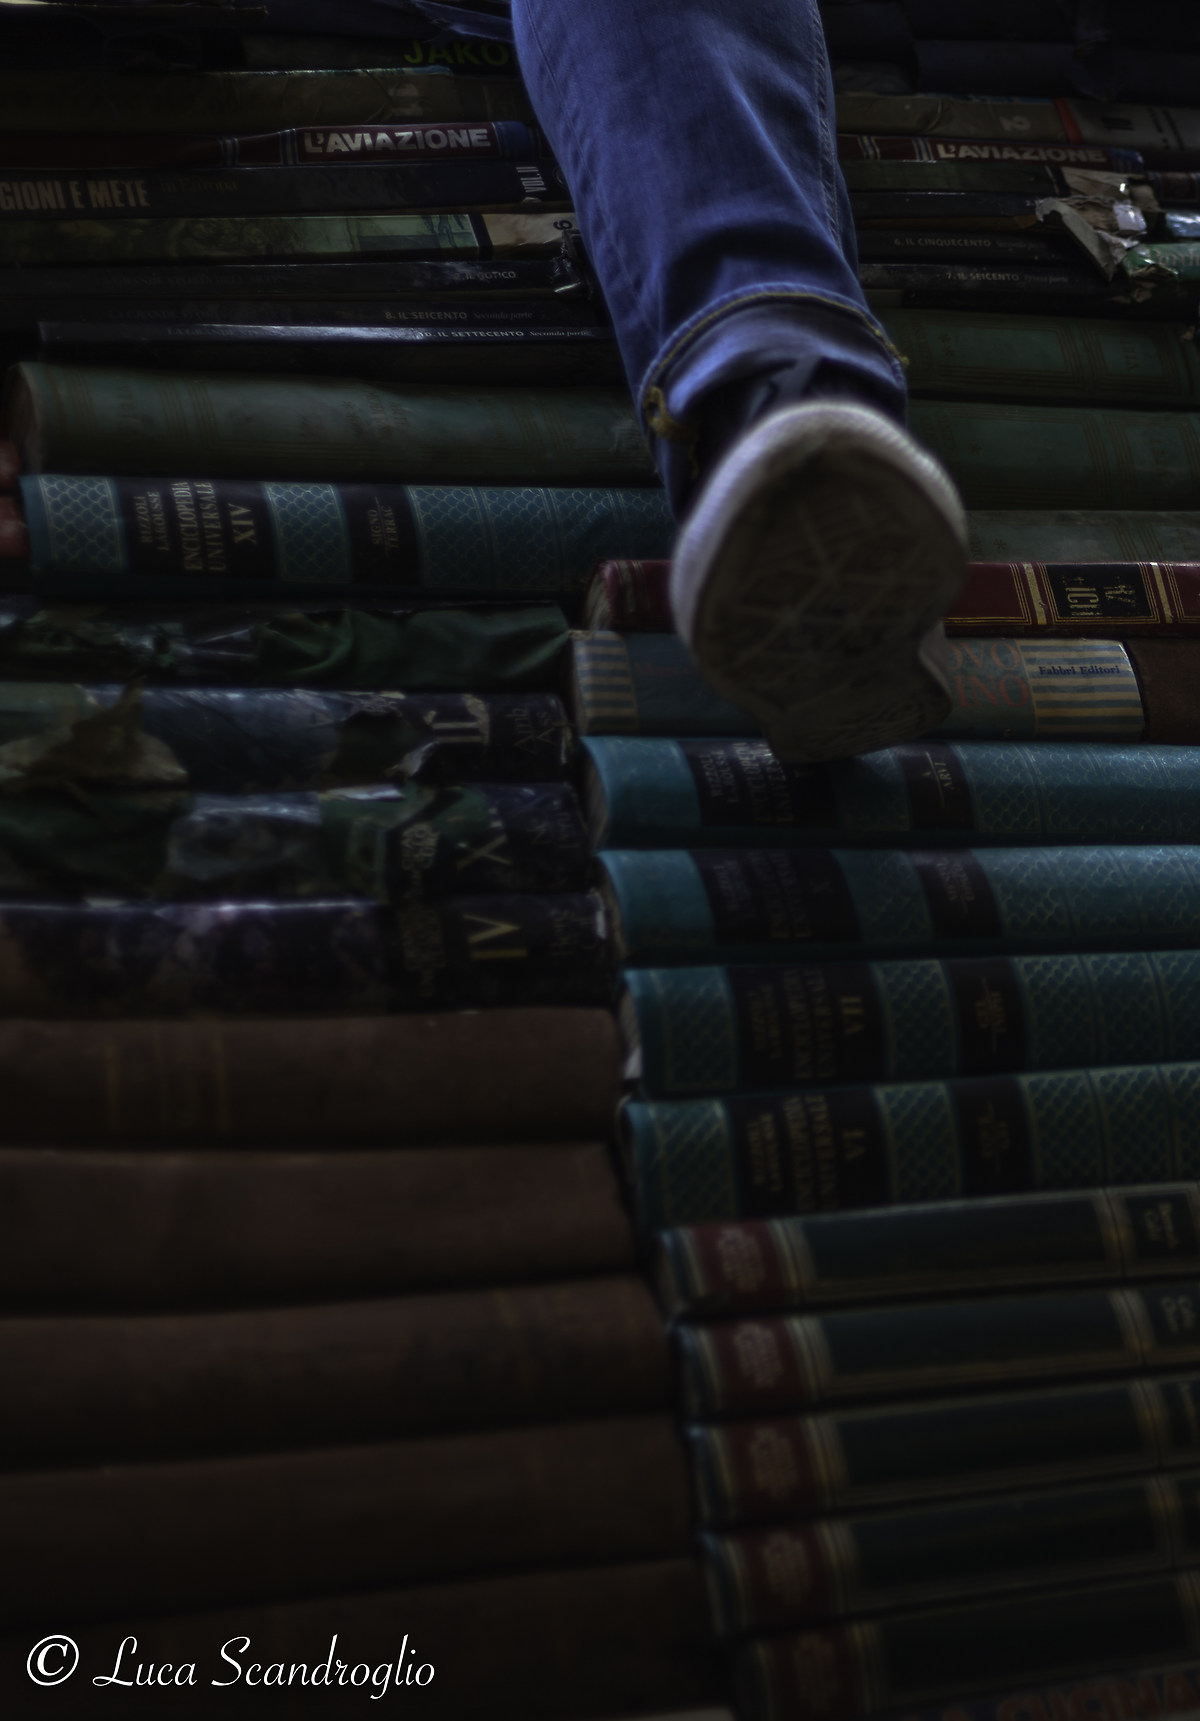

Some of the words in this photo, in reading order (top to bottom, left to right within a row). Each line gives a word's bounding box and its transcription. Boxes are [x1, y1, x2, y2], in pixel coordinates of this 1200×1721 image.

[302, 128, 493, 155] L'AVIAZIONE
[935, 142, 1109, 164] L'AVIAZIONE
[69, 180, 87, 209] E
[87, 180, 151, 209] METE
[917, 237, 992, 249] CINQUECENTO
[411, 310, 469, 321] SEICENTO
[451, 330, 525, 339] SETTECENTO
[133, 494, 153, 544] RIZZOLI
[171, 480, 205, 572] ENCICLOPEDIA
[196, 480, 228, 572] UNIVERSALE
[227, 502, 258, 546] XIV
[1038, 664, 1077, 677] Fabbri
[1079, 663, 1122, 676] Editori
